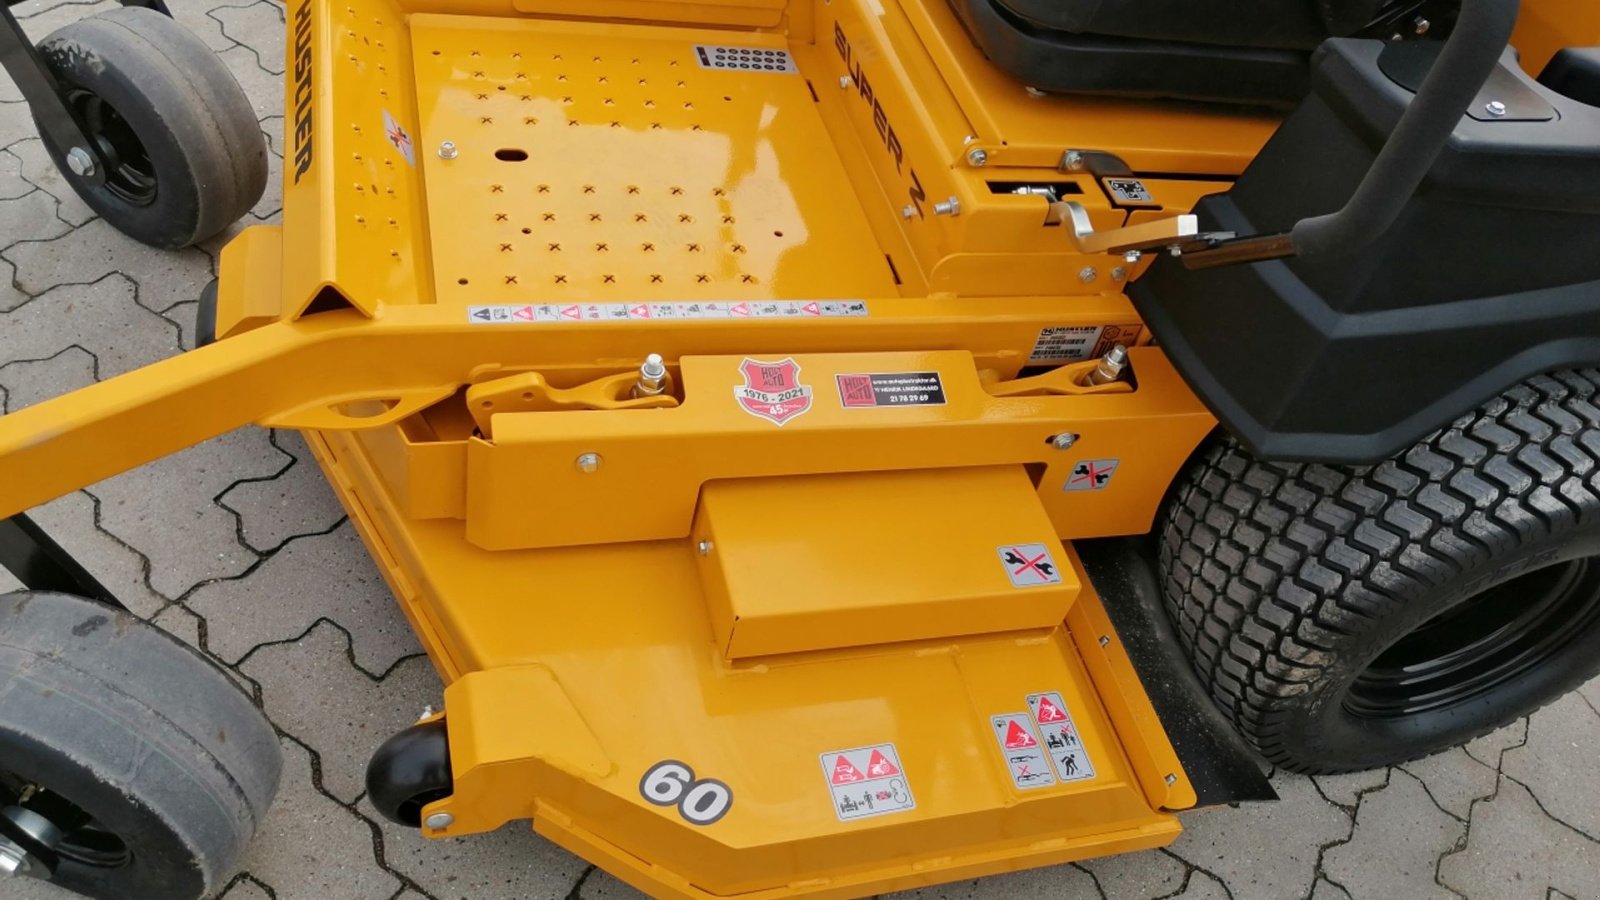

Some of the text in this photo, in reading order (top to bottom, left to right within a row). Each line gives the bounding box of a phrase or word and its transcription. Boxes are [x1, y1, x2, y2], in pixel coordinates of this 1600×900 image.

[294, 0, 313, 185] HUSTLER
[834, 20, 902, 176] SUPER
[744, 389, 769, 402] 1976
[778, 387, 804, 402] 2021
[769, 404, 784, 415] 45
[909, 394, 918, 402] 29
[639, 759, 733, 825] 60
